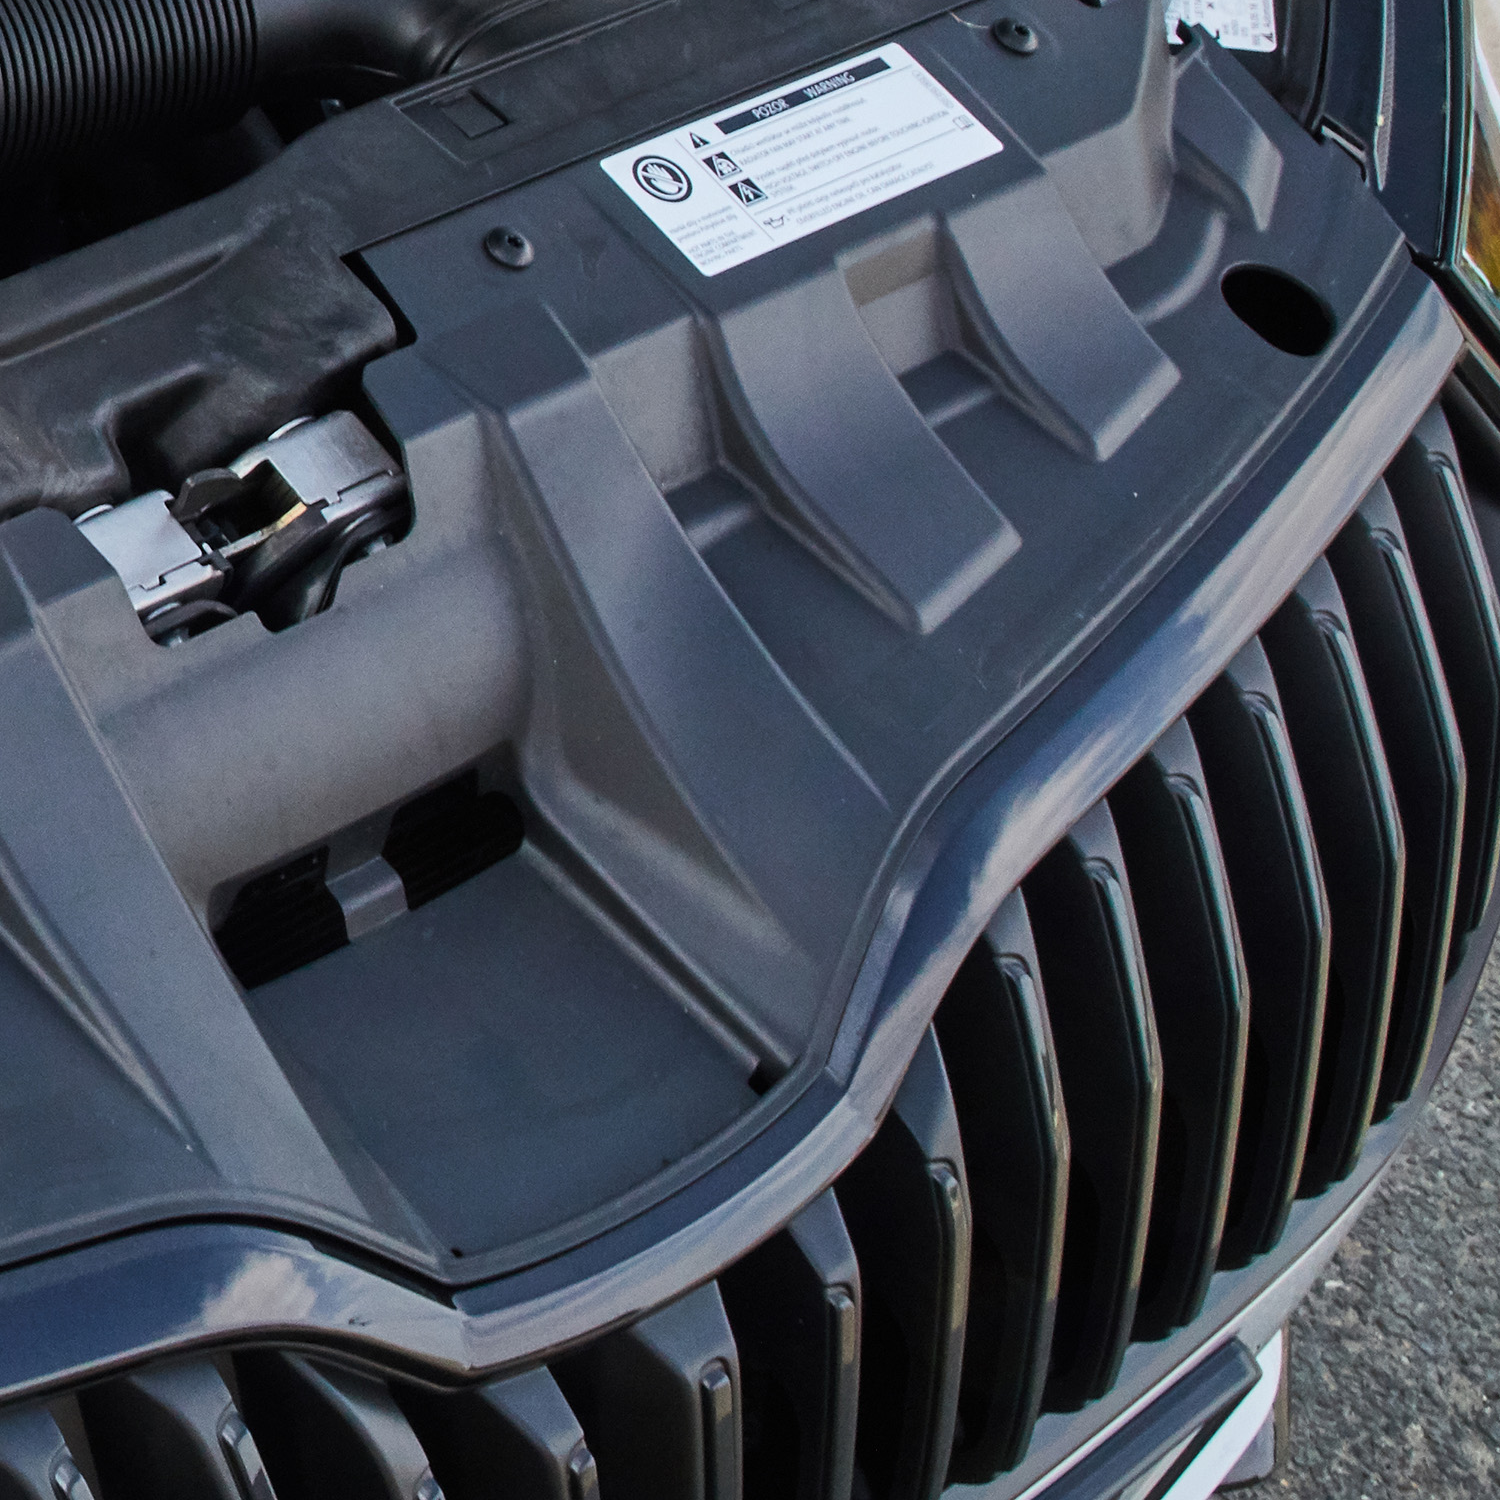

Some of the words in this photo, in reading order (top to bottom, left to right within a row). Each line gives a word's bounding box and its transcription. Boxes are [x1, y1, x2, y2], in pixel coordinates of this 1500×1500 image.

[750, 97, 791, 119] POZOR
[800, 70, 857, 99] WARNING
[793, 130, 816, 143] START
[812, 127, 823, 135] AT
[820, 121, 838, 131] ANY
[842, 142, 869, 157] ENGINE
[829, 195, 857, 210] ENGINE
